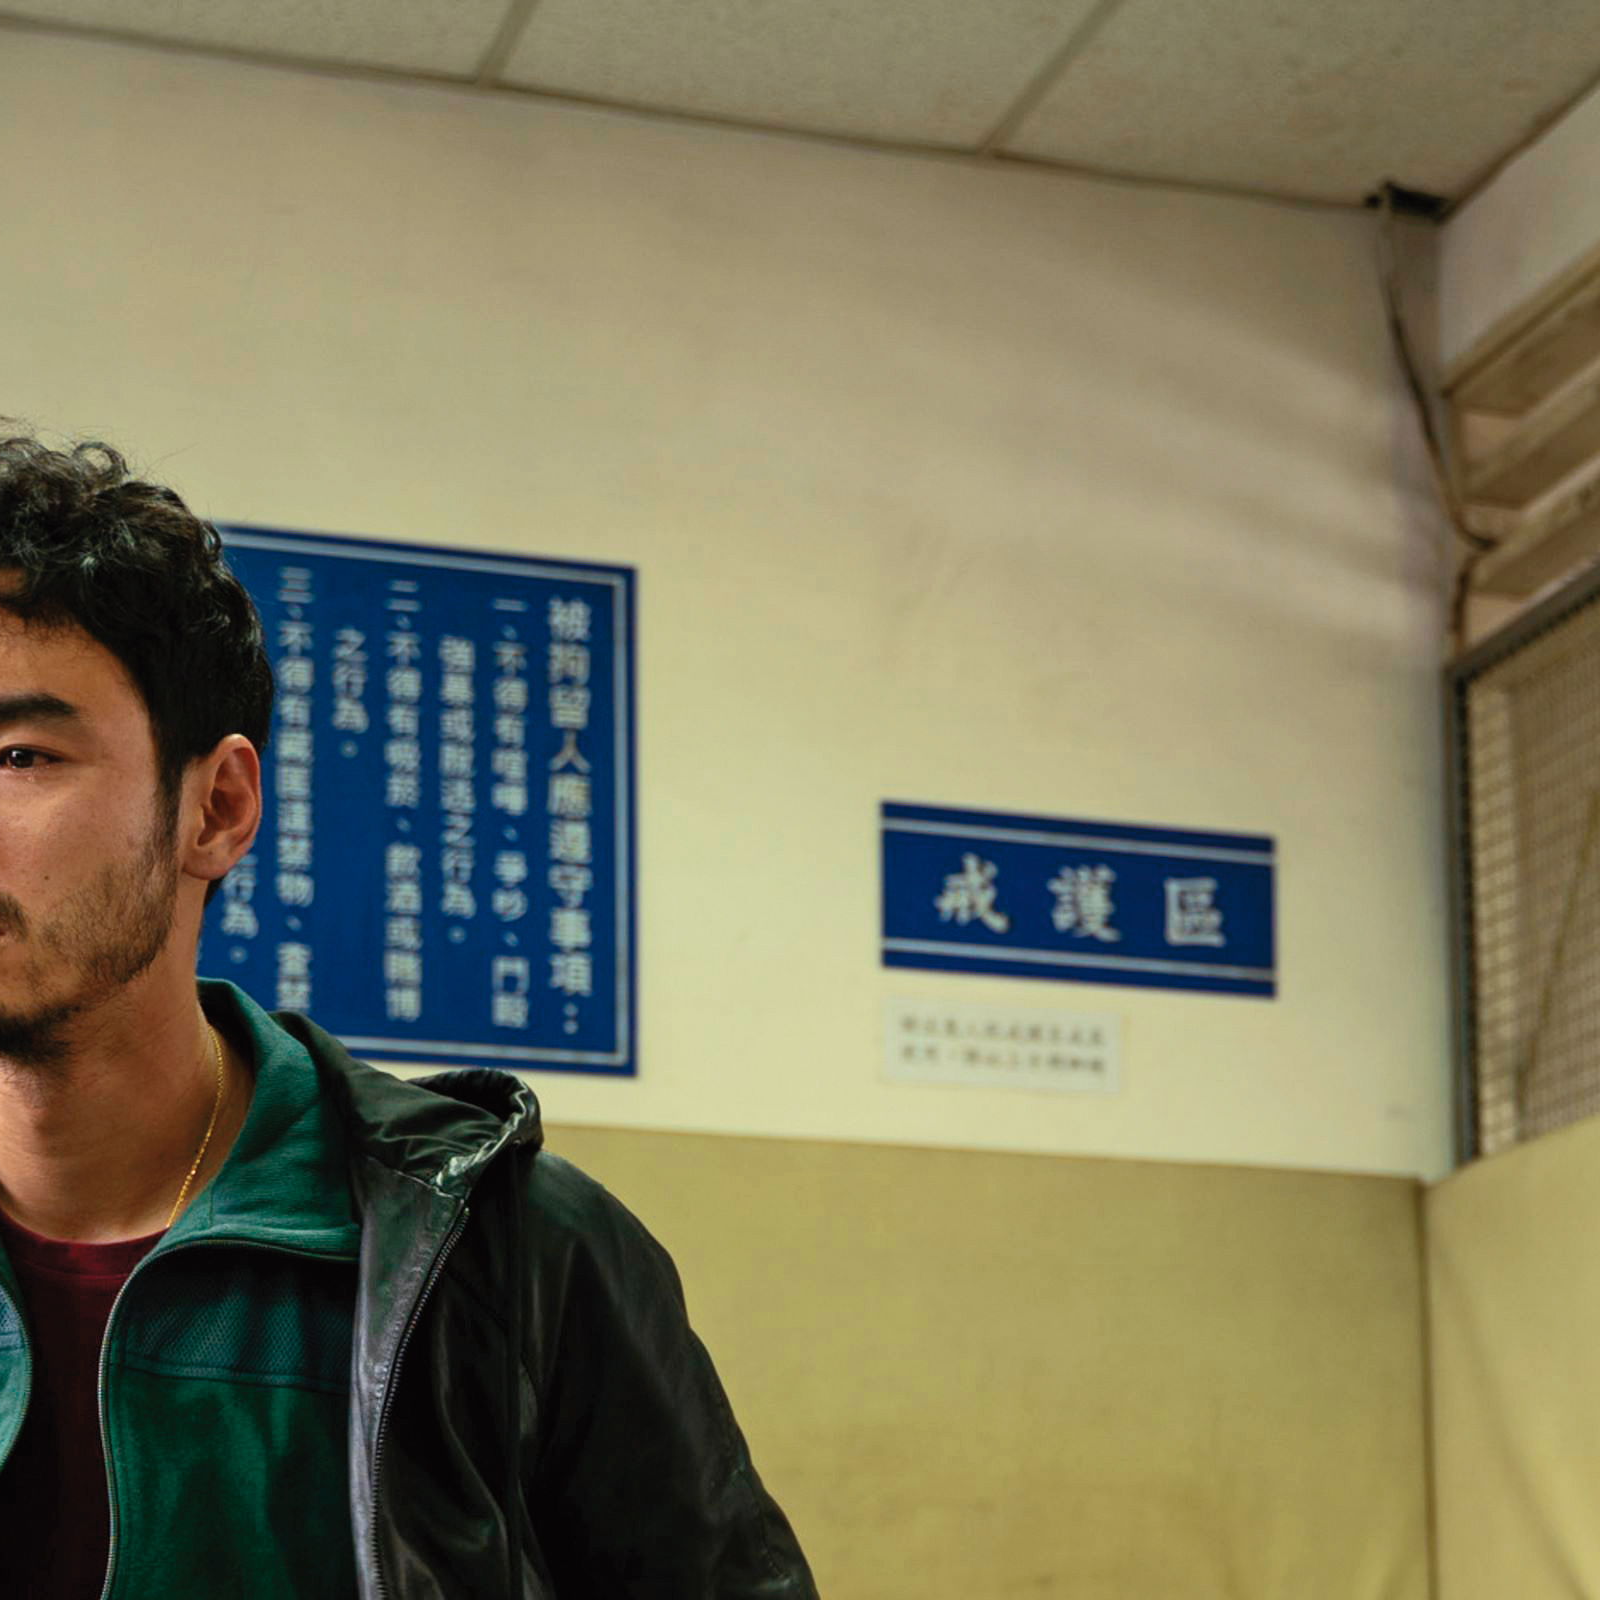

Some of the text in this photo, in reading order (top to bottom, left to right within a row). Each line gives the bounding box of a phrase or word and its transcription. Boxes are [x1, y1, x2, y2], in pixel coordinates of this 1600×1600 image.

[219, 852, 259, 964] 行為。
[933, 853, 1226, 947] 戒護區
